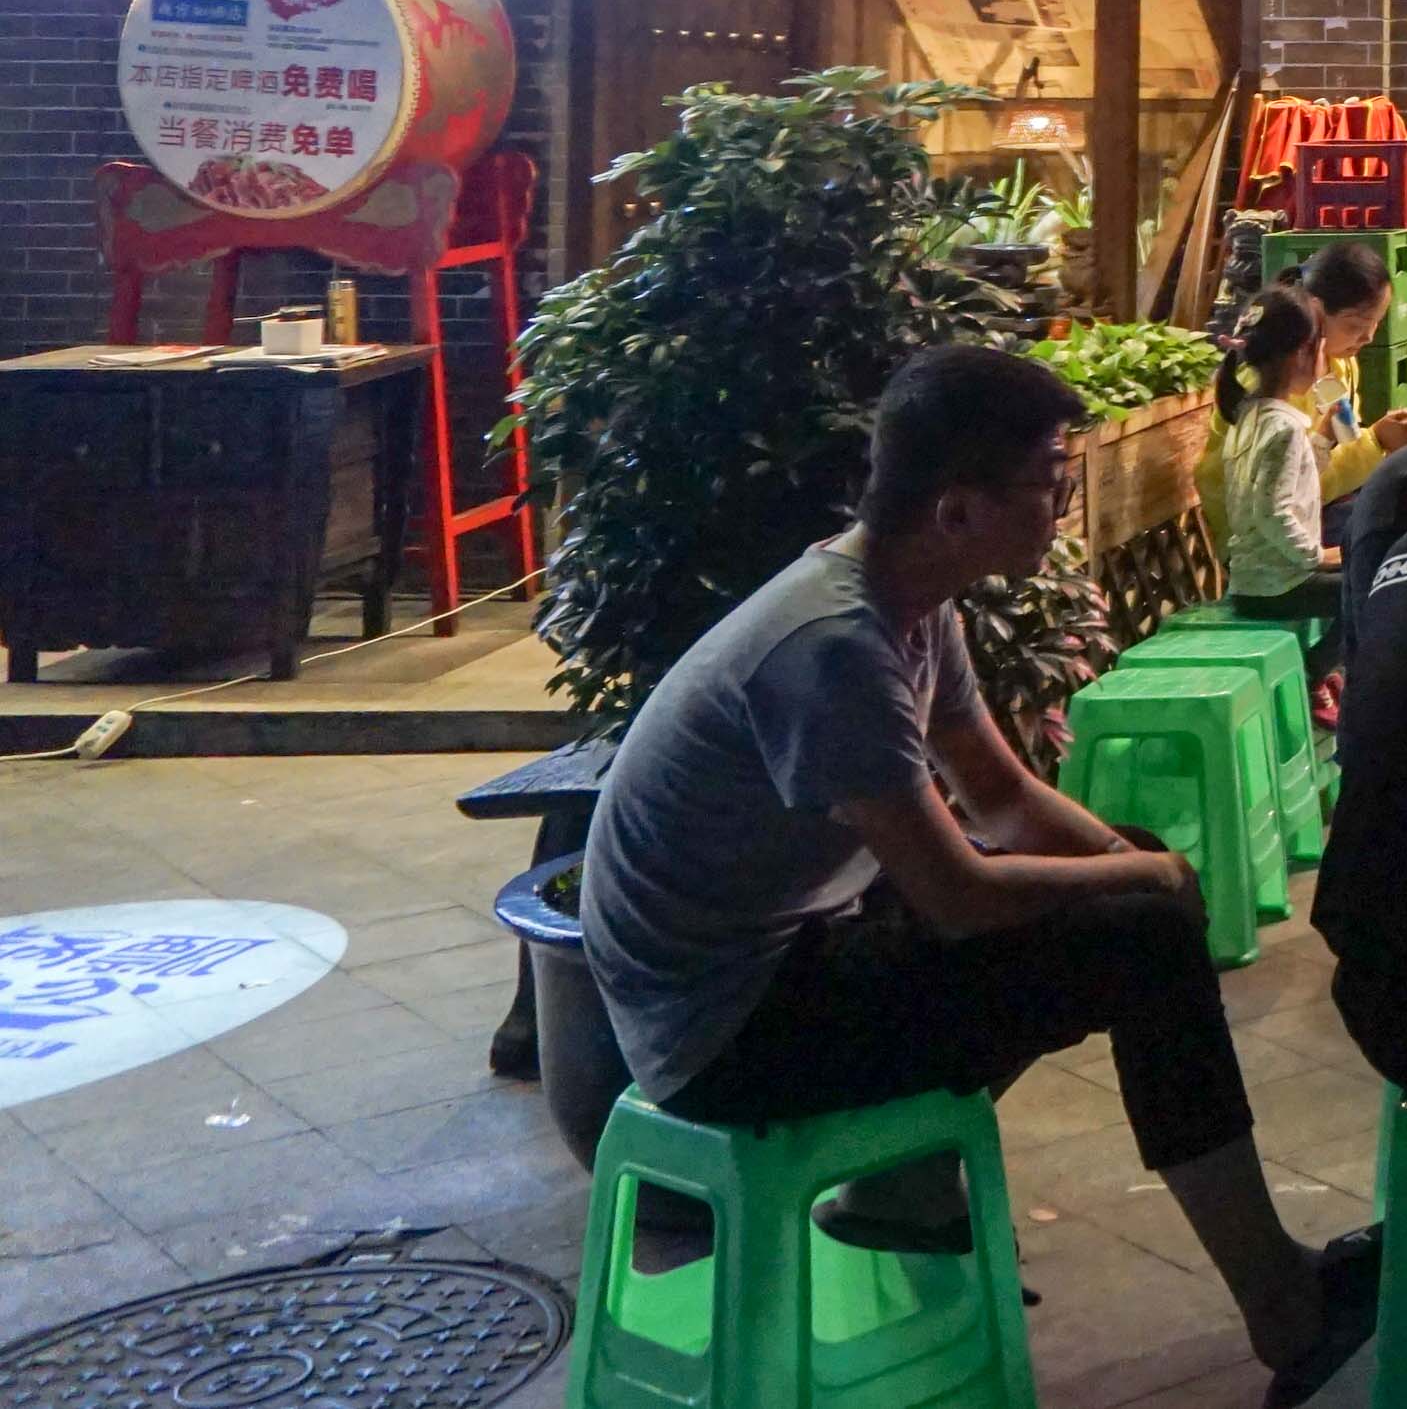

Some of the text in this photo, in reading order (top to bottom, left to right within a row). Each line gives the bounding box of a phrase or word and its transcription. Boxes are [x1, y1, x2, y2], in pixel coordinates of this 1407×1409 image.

[127, 64, 378, 103] 本店指定啤酒免费喝
[158, 116, 355, 159] 当餐消费免单
